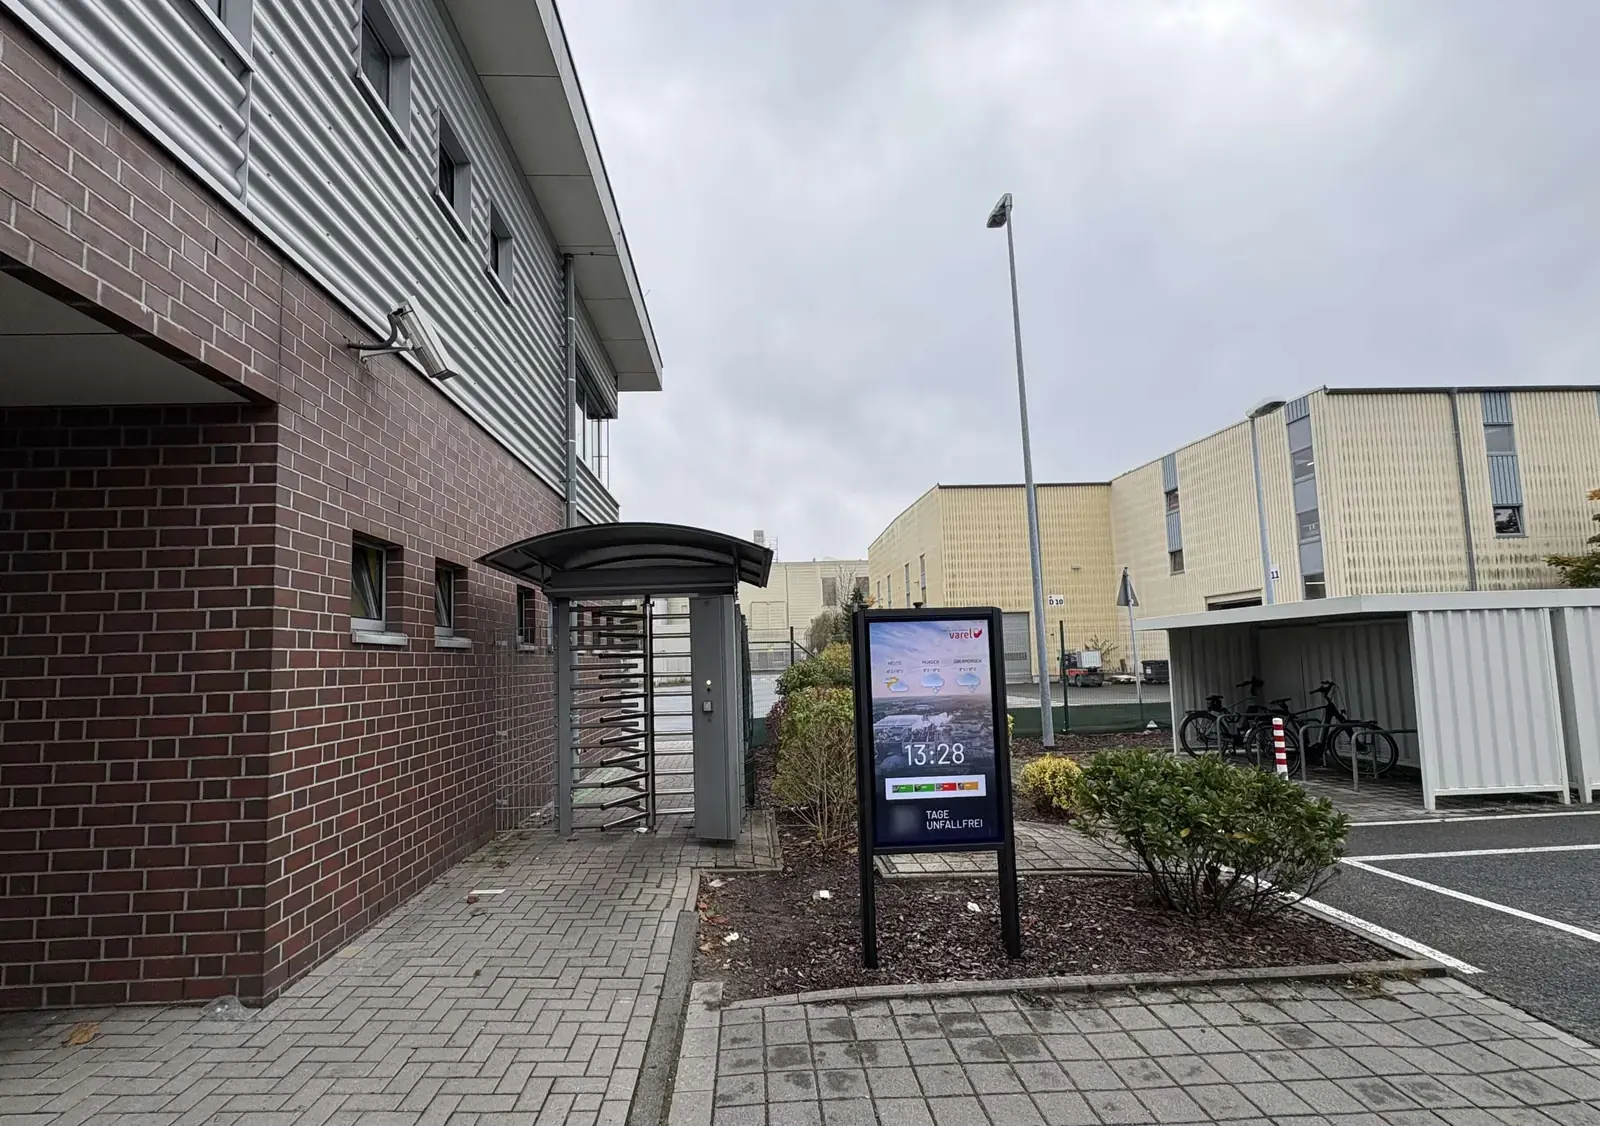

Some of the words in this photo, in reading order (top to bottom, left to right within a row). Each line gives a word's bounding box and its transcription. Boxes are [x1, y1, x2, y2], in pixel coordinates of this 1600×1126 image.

[1271, 570, 1279, 579] 11
[949, 628, 973, 639] varel
[904, 743, 965, 766] 13:28
[926, 810, 950, 820] TAGE
[926, 819, 983, 830] UNFALLFREI
